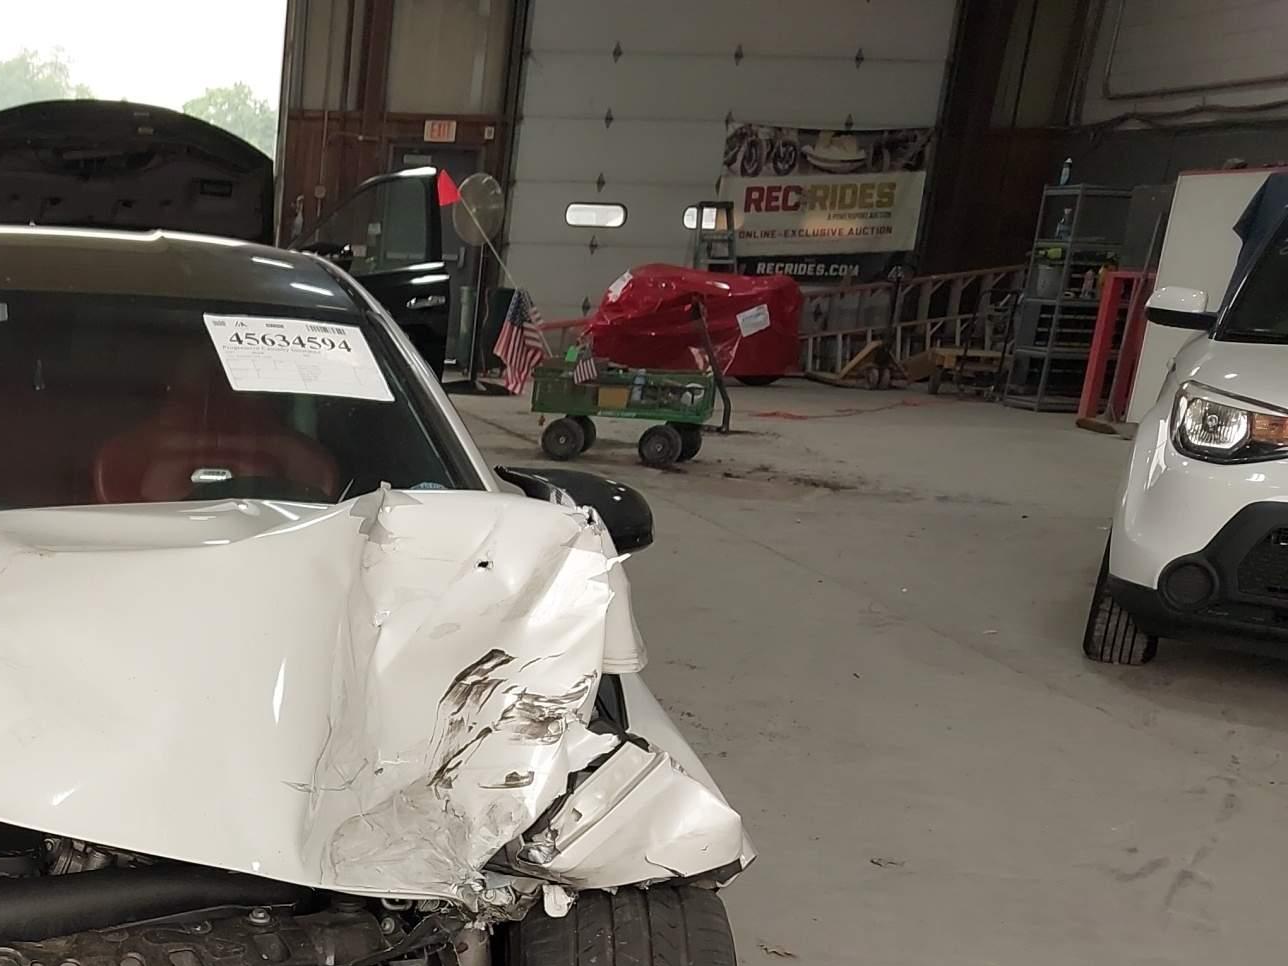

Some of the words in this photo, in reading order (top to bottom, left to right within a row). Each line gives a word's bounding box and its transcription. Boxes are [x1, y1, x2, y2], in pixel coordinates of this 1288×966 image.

[743, 185, 803, 213] REC
[807, 182, 896, 211] RIDES
[848, 225, 892, 237] AUCTION
[229, 332, 352, 352] 45634594
